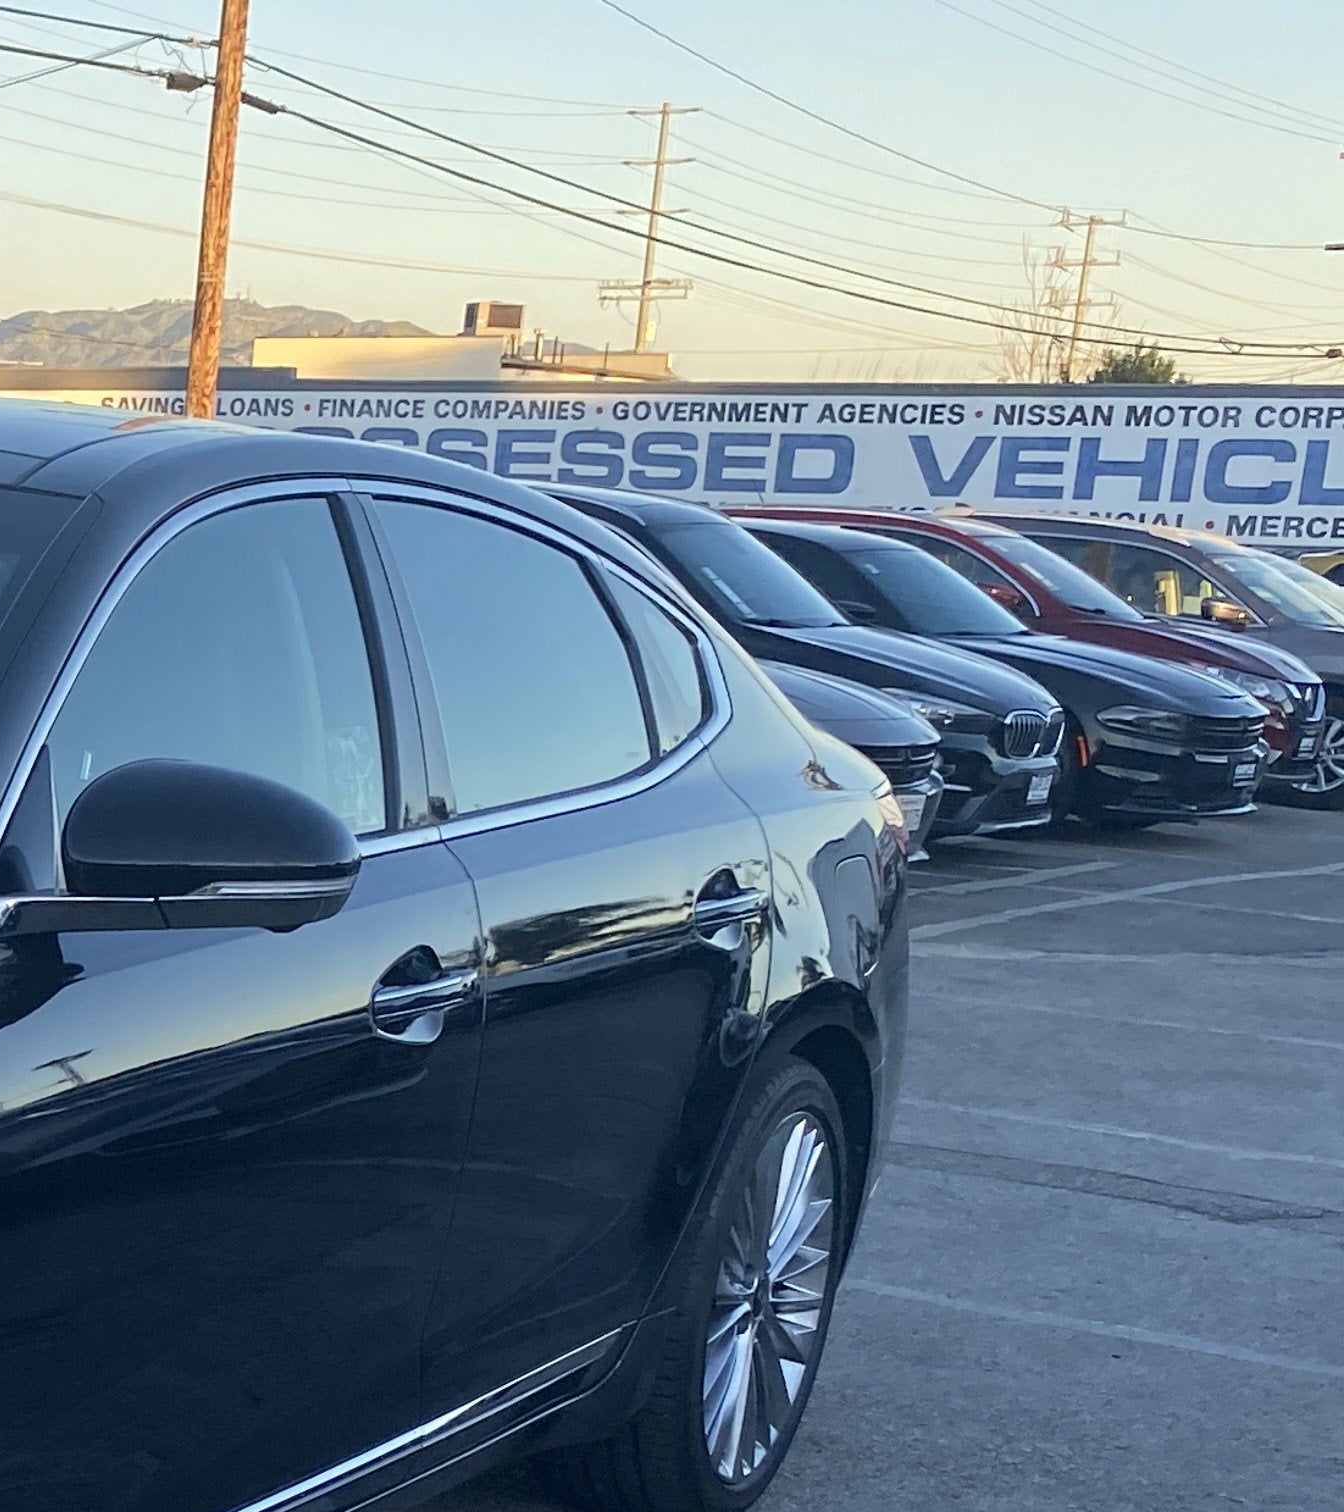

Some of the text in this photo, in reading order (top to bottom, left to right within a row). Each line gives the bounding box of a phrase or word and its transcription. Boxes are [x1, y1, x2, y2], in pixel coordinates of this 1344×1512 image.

[100, 396, 294, 418] SAVING LOANS
[317, 398, 587, 421] FINANCE COMPANIES
[611, 401, 966, 426] GOVERNMENT AGENCIES
[993, 404, 1344, 429] NISSAN MOTOR CORP
[908, 435, 1344, 506] VEHICL
[1226, 514, 1344, 539] MERCE
